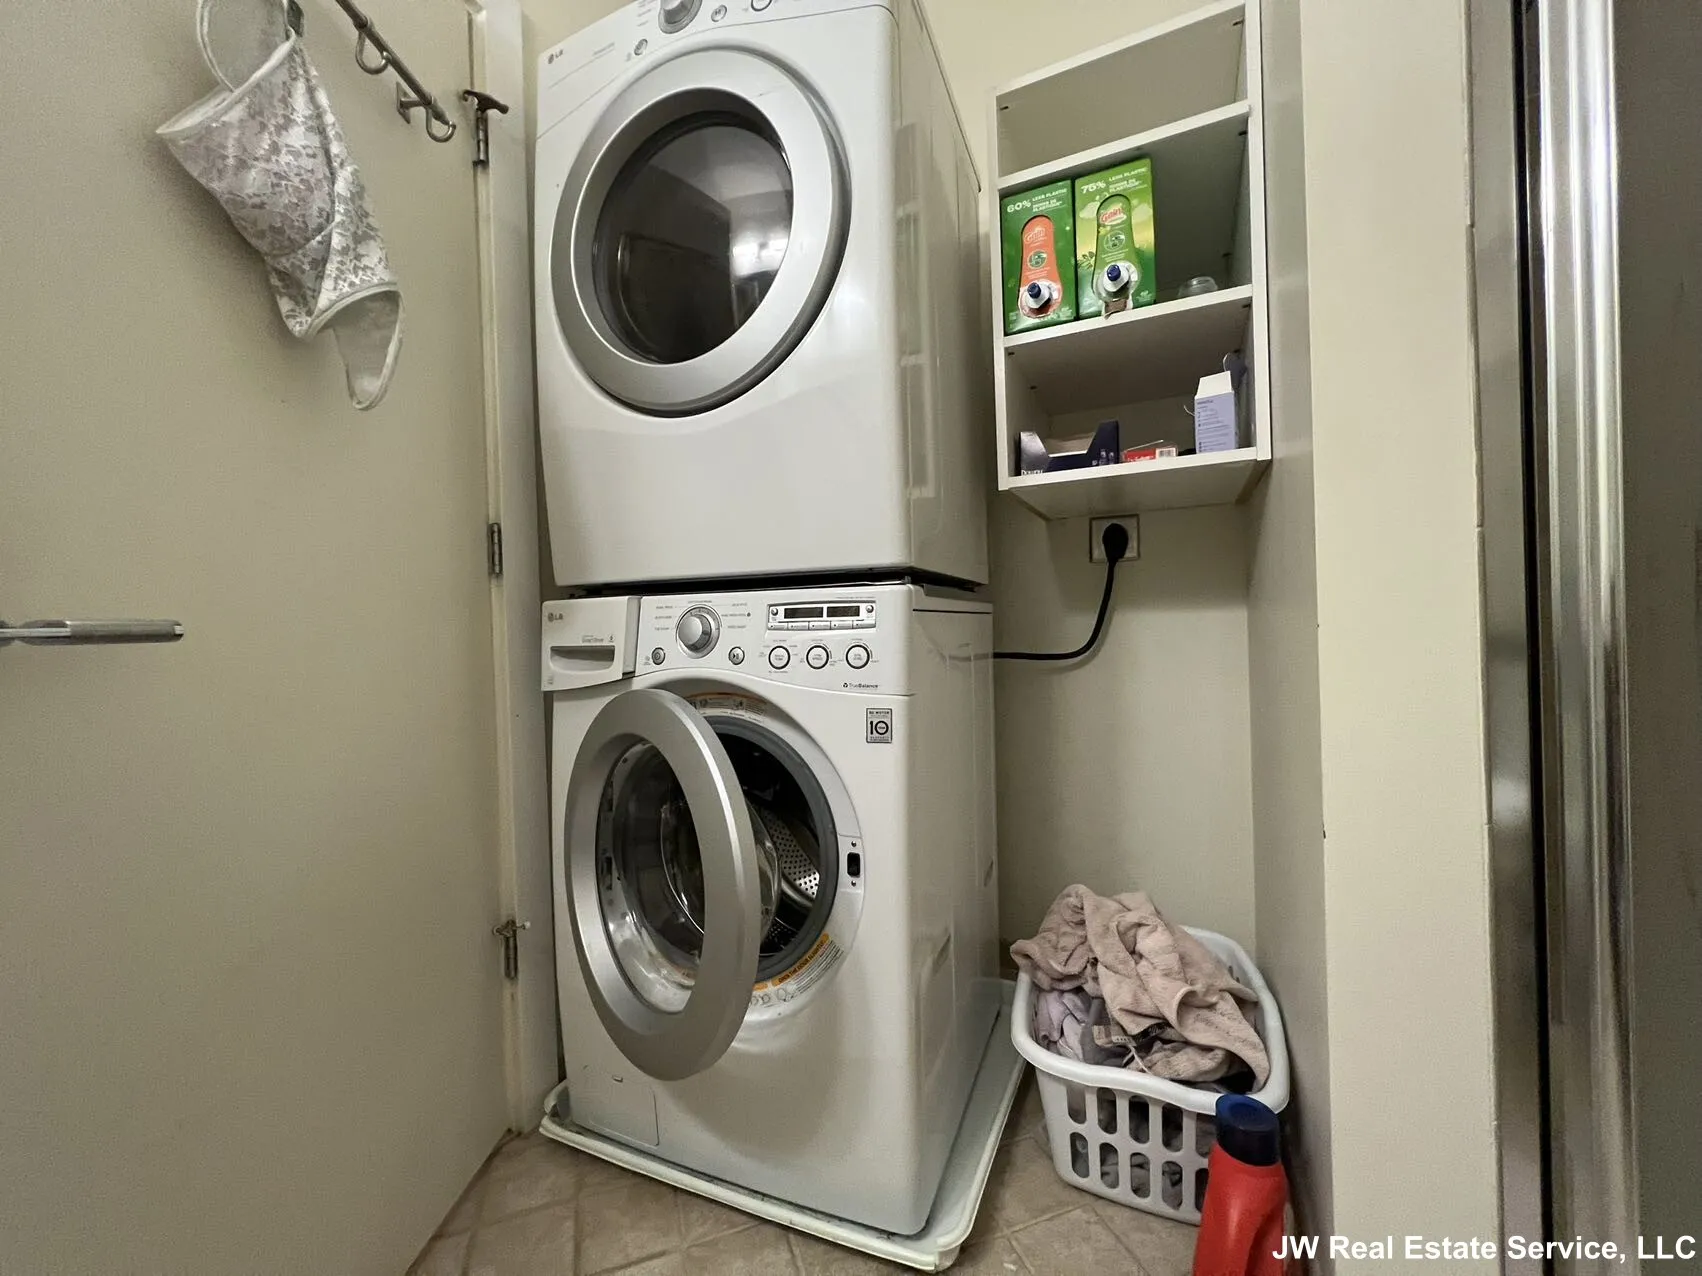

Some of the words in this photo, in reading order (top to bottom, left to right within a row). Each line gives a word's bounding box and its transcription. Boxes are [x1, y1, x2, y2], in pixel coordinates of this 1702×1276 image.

[1081, 180, 1107, 194] 75%
[1007, 199, 1033, 213] 60%
[1100, 207, 1123, 222] Gain
[869, 720, 890, 736] 10
